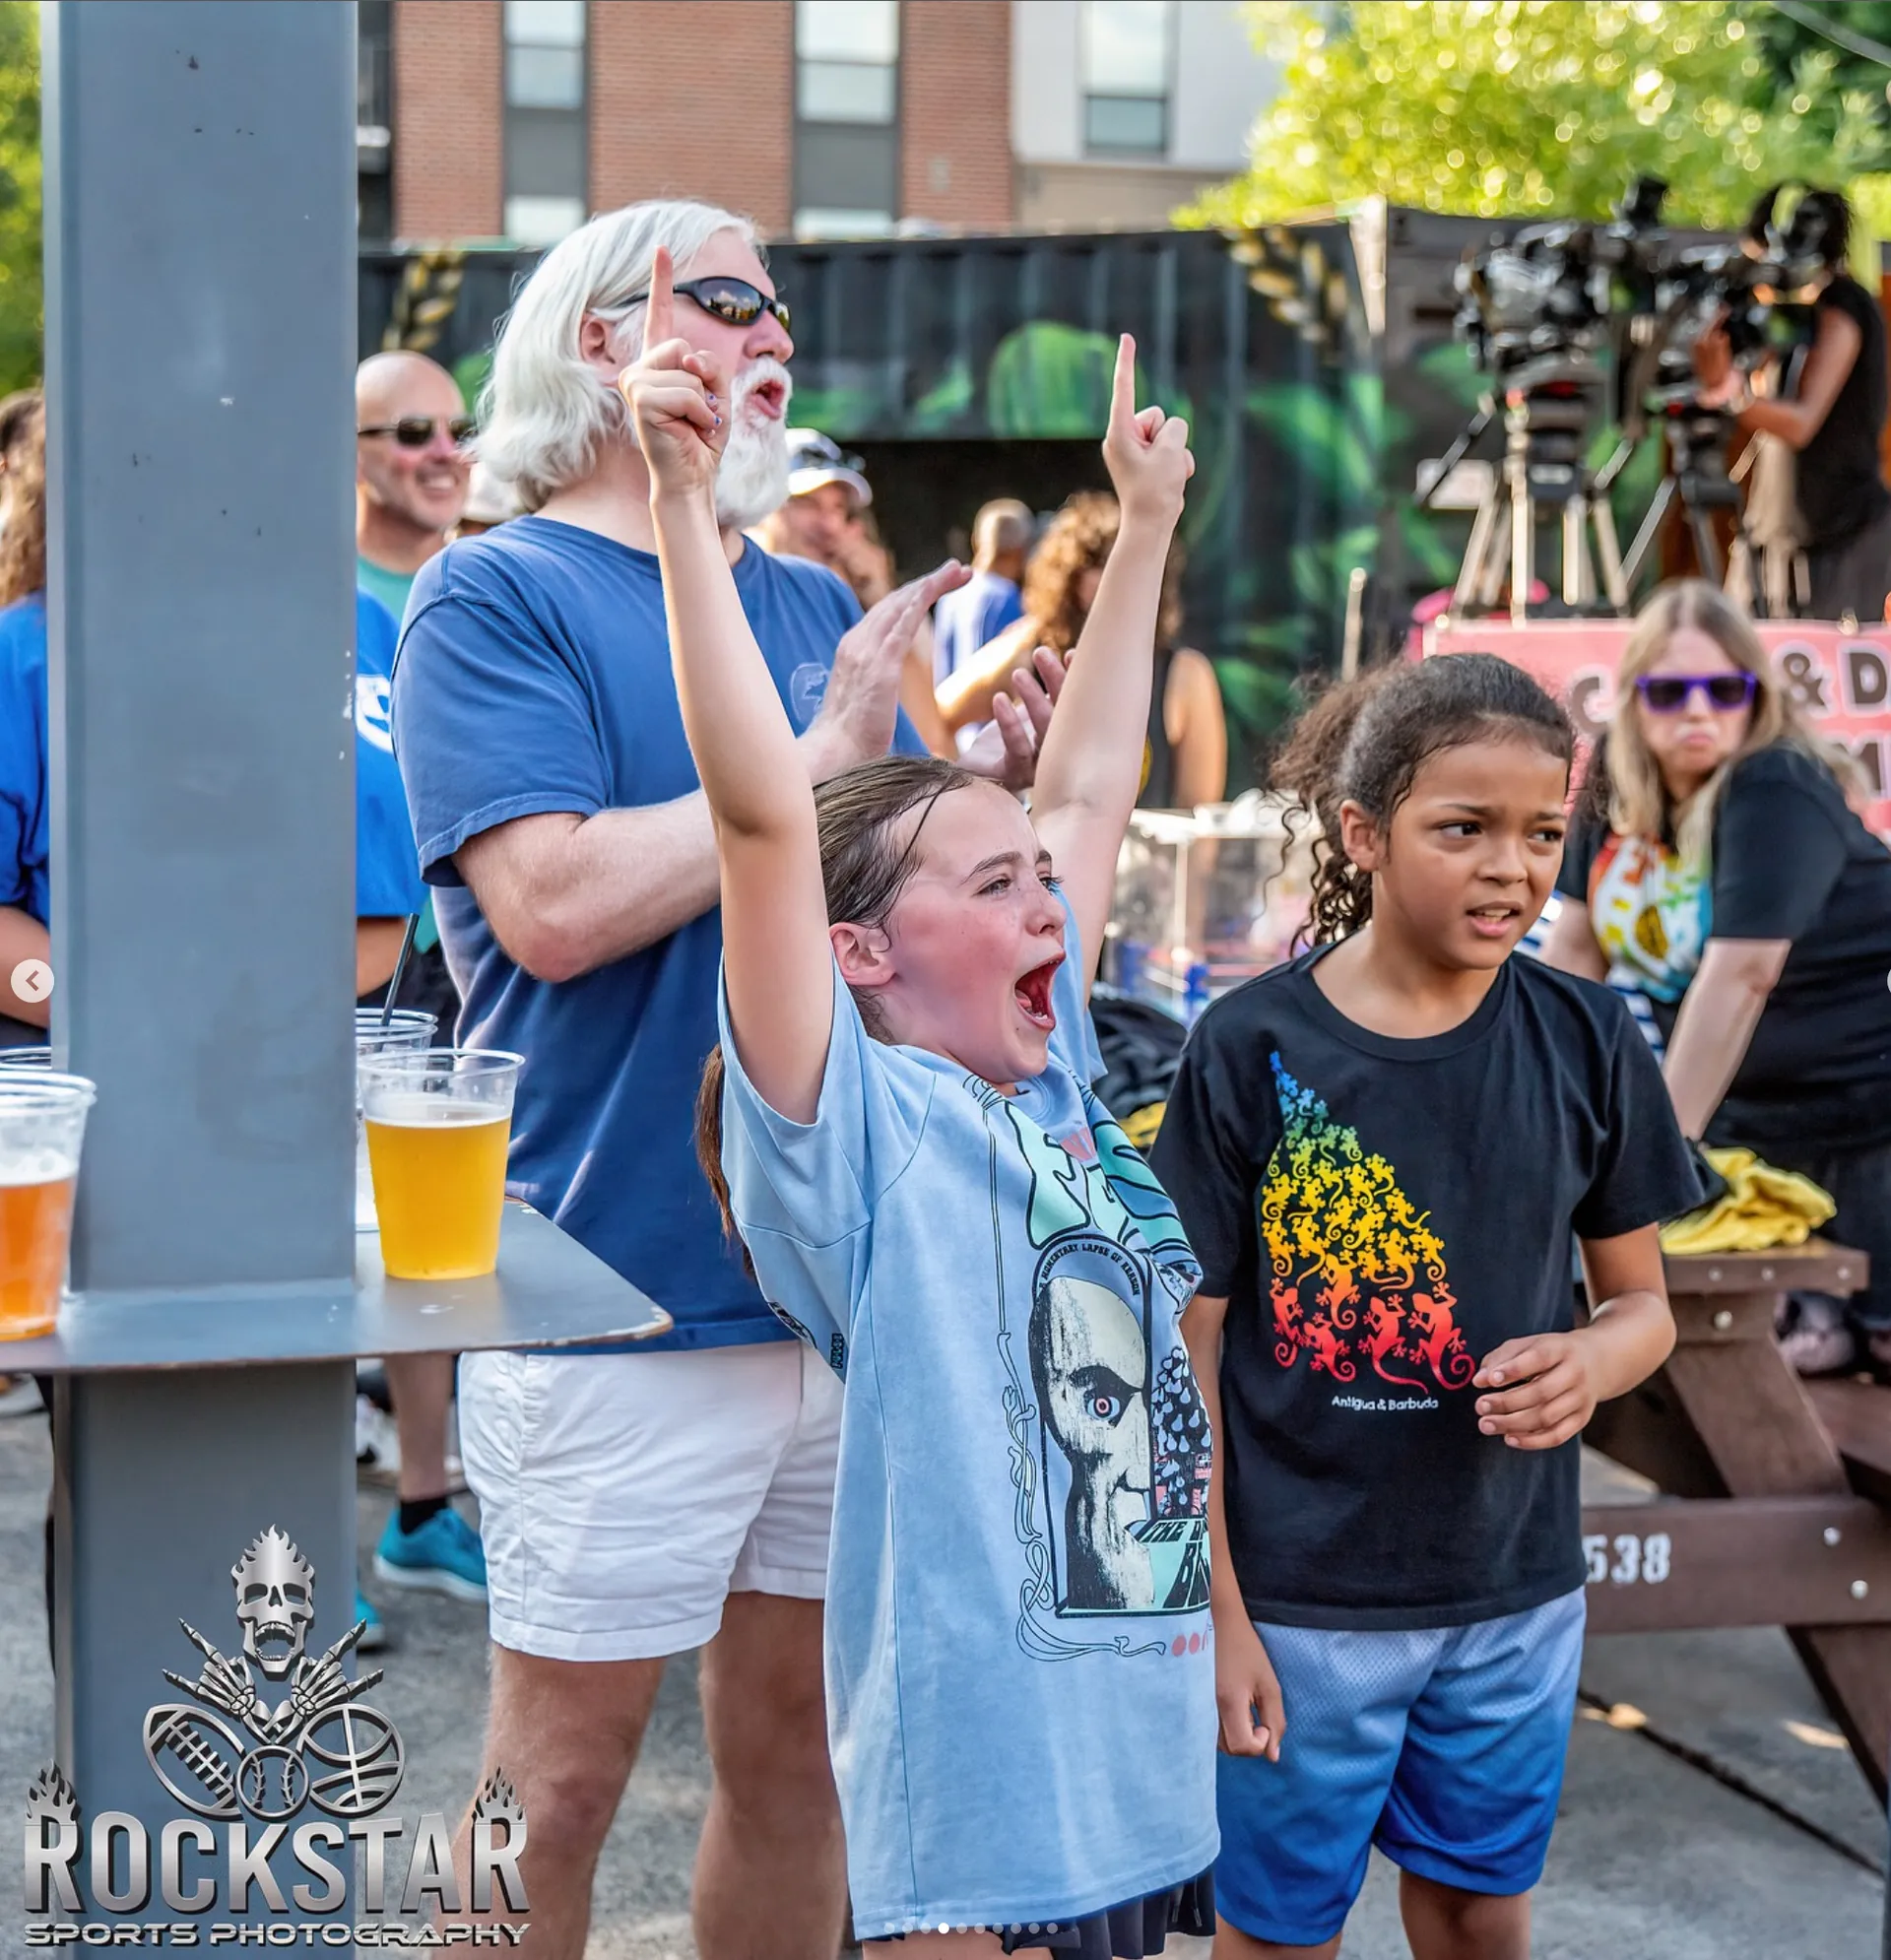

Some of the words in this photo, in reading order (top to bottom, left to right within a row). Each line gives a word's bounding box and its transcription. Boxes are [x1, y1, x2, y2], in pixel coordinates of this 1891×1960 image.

[1779, 649, 1828, 709] &
[1041, 1243, 1078, 1280] MOMENTARY
[1081, 1243, 1110, 1257] LAPSE
[1110, 1251, 1123, 1264] OF
[1121, 1262, 1141, 1296] REASON
[1332, 1396, 1376, 1410] Antigua
[1377, 1402, 1387, 1411] &
[1388, 1397, 1439, 1410] Barbuda
[1141, 1522, 1188, 1542] THE
[1582, 1534, 1671, 1585] 538
